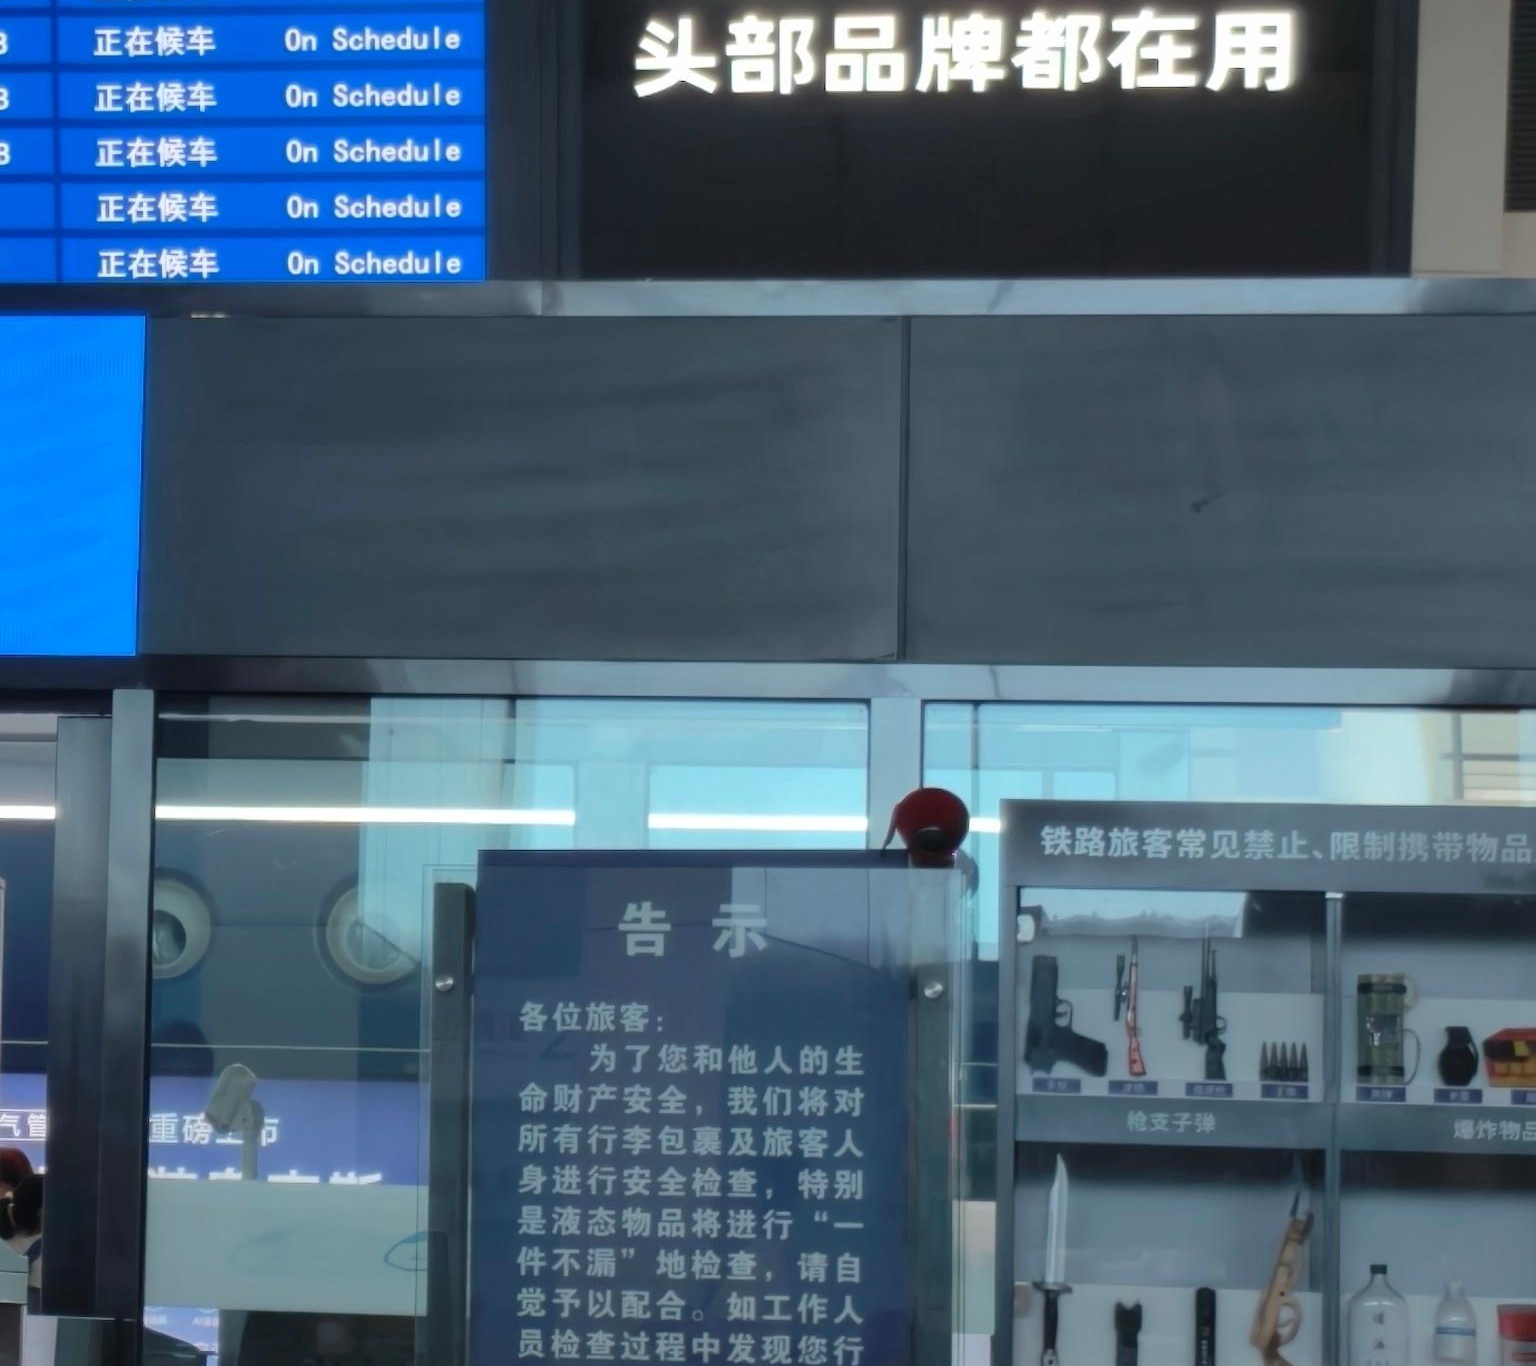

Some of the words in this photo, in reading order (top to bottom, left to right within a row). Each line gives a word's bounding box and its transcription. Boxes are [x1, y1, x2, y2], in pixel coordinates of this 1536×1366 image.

[94, 26, 215, 56] 正在候车
[285, 28, 316, 51] On
[333, 27, 460, 51] Schedule
[634, 13, 1296, 98] 头部品牌都在用
[95, 82, 216, 112] 正在候车
[286, 84, 317, 107] On
[334, 83, 460, 107] Schedule
[96, 137, 217, 167] 正在候车
[286, 140, 318, 162] On
[334, 139, 460, 162] Schedule
[98, 192, 217, 222] 正在候车
[287, 195, 318, 218] On
[335, 195, 461, 218] Schedule
[98, 249, 218, 278] 正在候车
[288, 251, 319, 274] On
[335, 251, 461, 274] Schedule
[619, 902, 767, 957] 告示
[590, 1044, 864, 1076] 为了您和他人的生
[518, 1084, 864, 1117] 命财产安全，我们将对
[518, 1125, 864, 1159] 所有行李包裹及旅客人
[518, 1166, 864, 1199] 身进行安全检查，特别
[517, 1329, 864, 1366] 员检查过程中发现您行
